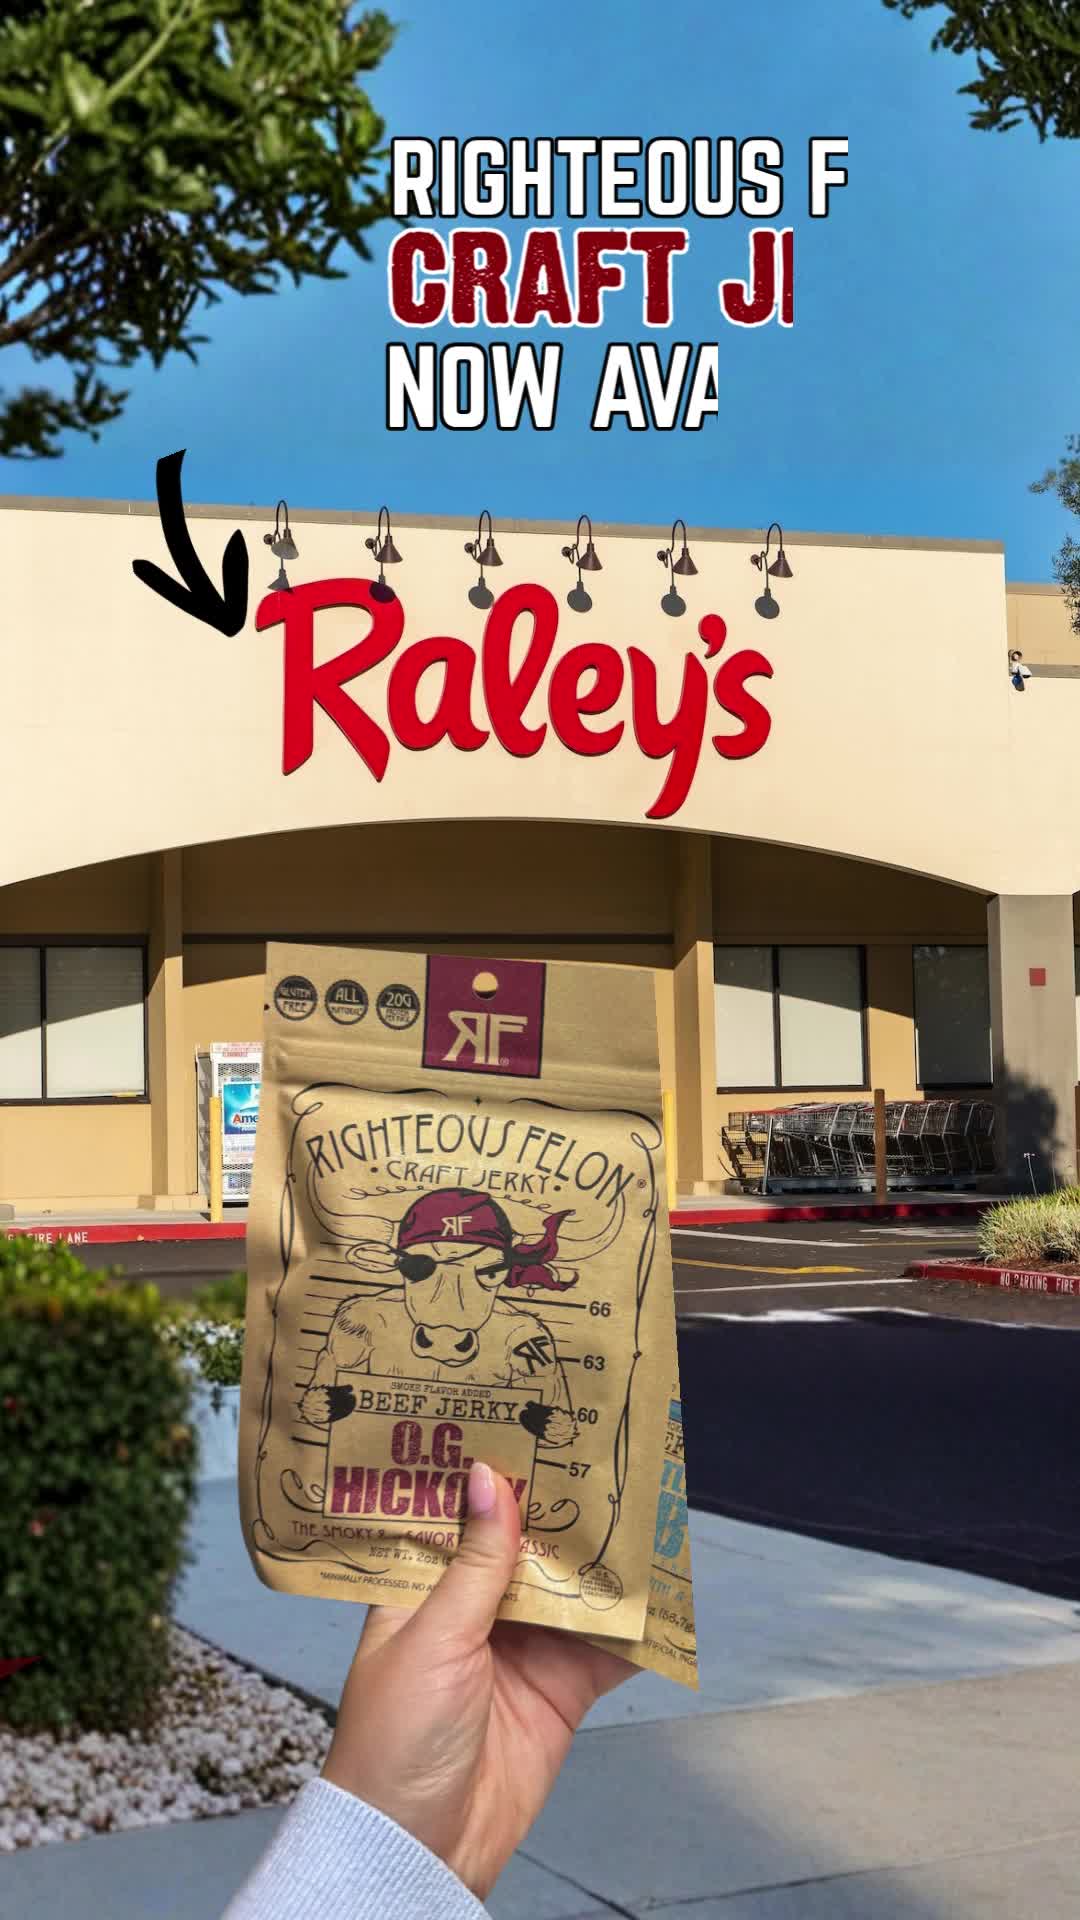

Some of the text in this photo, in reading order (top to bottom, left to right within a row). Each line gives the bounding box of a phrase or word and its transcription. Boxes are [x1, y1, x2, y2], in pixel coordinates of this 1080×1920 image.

[255, 578, 773, 819] Raley's
[335, 987, 359, 1002] ALL
[386, 992, 412, 1007] 20G
[283, 1001, 306, 1013] FREE
[305, 1114, 635, 1207] RIGHTEOUS FELON
[386, 1160, 549, 1194] CRAFT JERKY
[1000, 1272, 1010, 1287] NO
[1013, 1273, 1048, 1291] PARKING
[1056, 1278, 1074, 1294] FIRE
[589, 1301, 611, 1317] 66
[584, 1355, 605, 1371] 63
[391, 1382, 491, 1398] SMOKE FLAVOR ADDED
[360, 1389, 519, 1421] BEEF JERKY
[577, 1408, 598, 1424] 60
[391, 1420, 473, 1469] O.G.
[569, 1462, 591, 1478] 57
[330, 1466, 528, 1518] HICKOY
[292, 1521, 314, 1536] THE
[322, 1524, 371, 1540] SMOKY
[412, 1582, 426, 1592] NO
